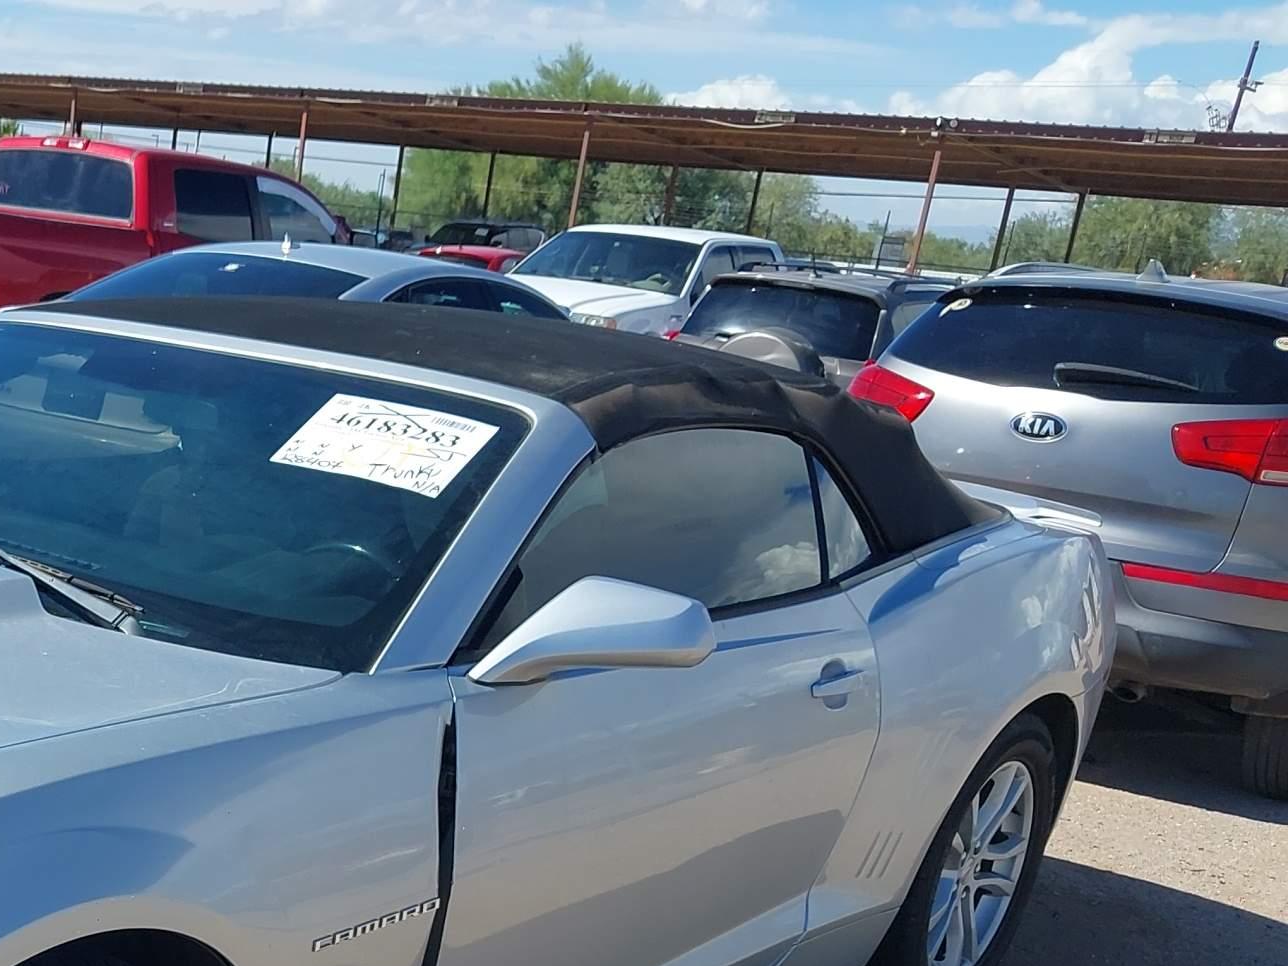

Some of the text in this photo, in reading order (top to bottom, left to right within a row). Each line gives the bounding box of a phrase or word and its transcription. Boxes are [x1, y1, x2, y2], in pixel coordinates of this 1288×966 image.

[330, 412, 461, 448] 46183283
[1018, 417, 1055, 436] KIA
[412, 480, 440, 494] N/A
[312, 897, 441, 952] CAMARO
